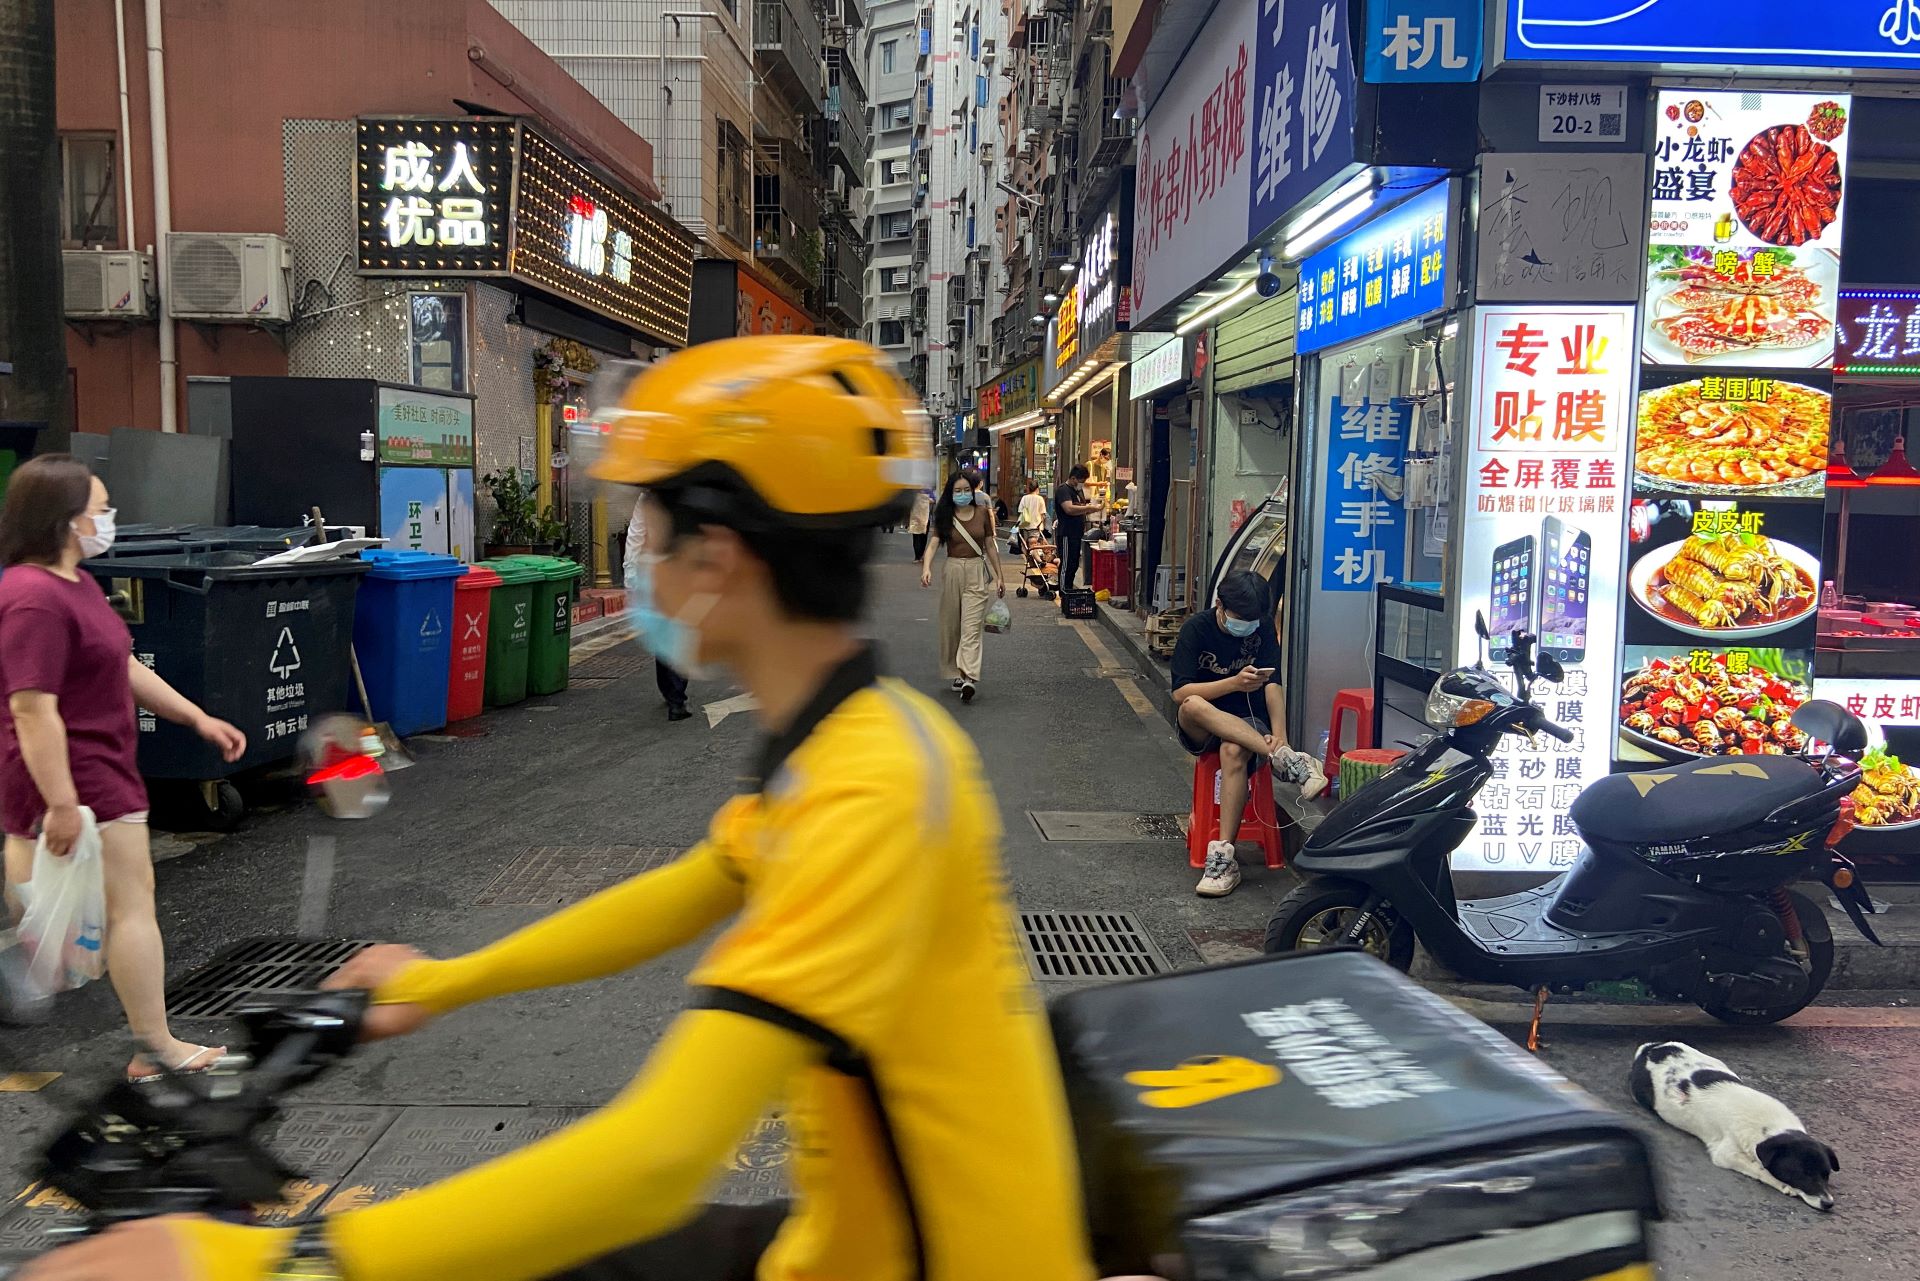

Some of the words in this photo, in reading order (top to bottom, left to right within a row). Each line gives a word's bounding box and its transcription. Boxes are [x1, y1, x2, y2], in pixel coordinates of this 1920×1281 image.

[1382, 15, 1468, 70] 机
[1256, 2, 1342, 206] 维修
[1546, 92, 1601, 106] 下沙村八坊
[1552, 115, 1592, 133] 20-2
[1655, 135, 1734, 163] 小龙虾
[384, 140, 486, 193] 成人
[1652, 163, 1717, 201] 盛宴
[384, 195, 486, 247] 优品
[1423, 212, 1443, 249] 手机
[1421, 249, 1442, 286] 配件
[1714, 251, 1775, 276] 螃蟹
[1495, 322, 1609, 377] 专业
[1700, 376, 1774, 402] 基围虾
[394, 403, 428, 422] 美好社区
[1490, 389, 1606, 443] 贴膜
[1479, 457, 1617, 489] 全屏覆盖
[1333, 404, 1401, 584] 维修手机
[1478, 495, 1615, 513] 防爆钢化玻璃膜
[1691, 510, 1765, 535] 皮皮虾
[1689, 650, 1750, 675] 花螺
[267, 683, 304, 703] 其他垃圾
[1845, 693, 1920, 720] 皮皮虾
[265, 714, 307, 740] 万物云城
[1489, 757, 1582, 779] 磨砂膜
[1480, 783, 1583, 809] 钻石膜
[1480, 814, 1579, 836] 蓝光膜
[1648, 845, 1689, 856] YAMAHA
[1349, 911, 1372, 938] YAMAHA
